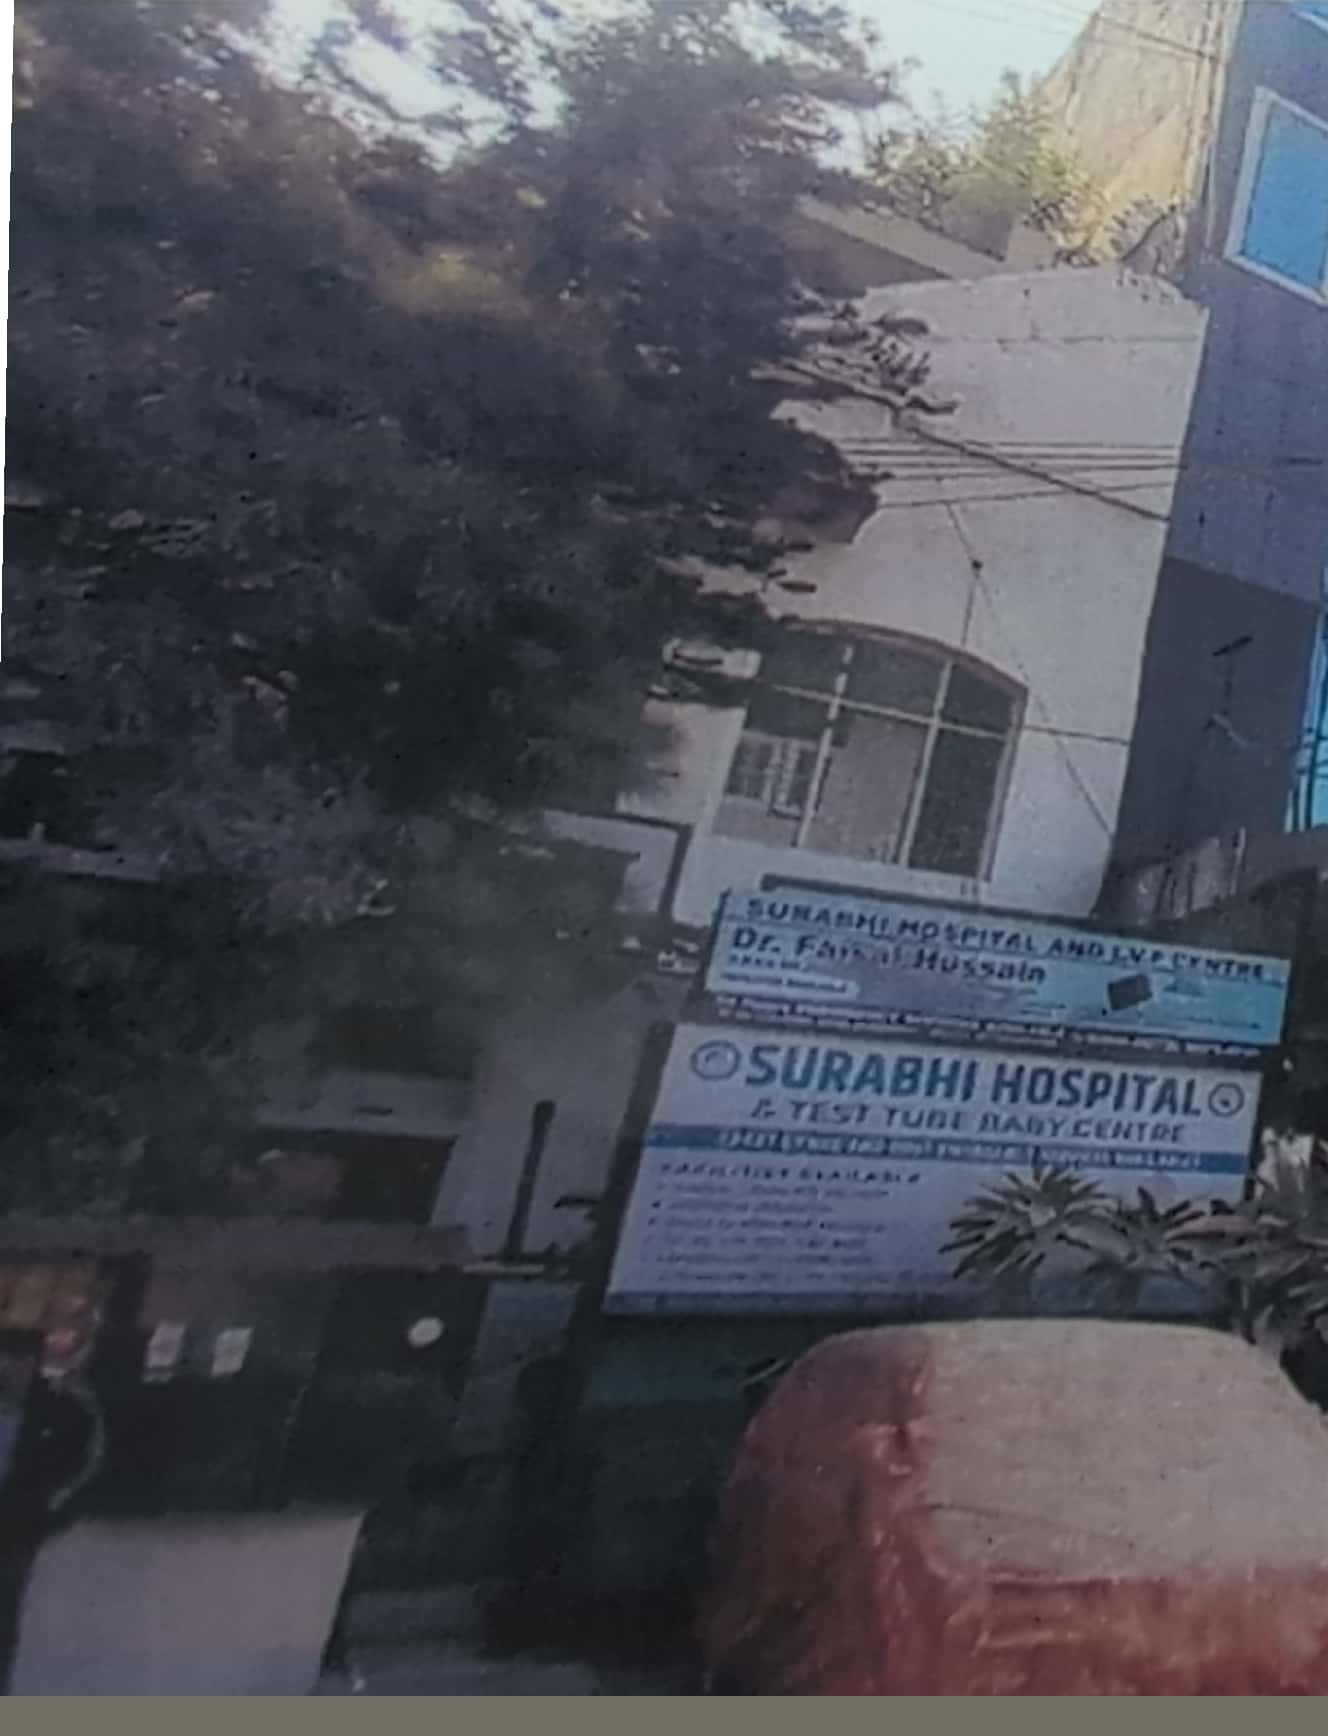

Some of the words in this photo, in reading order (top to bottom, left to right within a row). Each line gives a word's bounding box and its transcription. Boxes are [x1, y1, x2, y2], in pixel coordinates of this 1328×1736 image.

[733, 926, 781, 953] Dr.
[911, 947, 1046, 982] Hussain
[748, 899, 888, 935] SURABHI
[898, 918, 1036, 951] HOSPITAL
[1050, 937, 1099, 957] AND
[746, 1044, 978, 1101] SURABHI
[992, 1063, 1201, 1117] HOSPITAL
[788, 1100, 871, 1125] TEST
[884, 1104, 962, 1130] TUBE
[978, 1111, 1068, 1137] BABY
[1071, 1115, 1186, 1143] CENTRE
